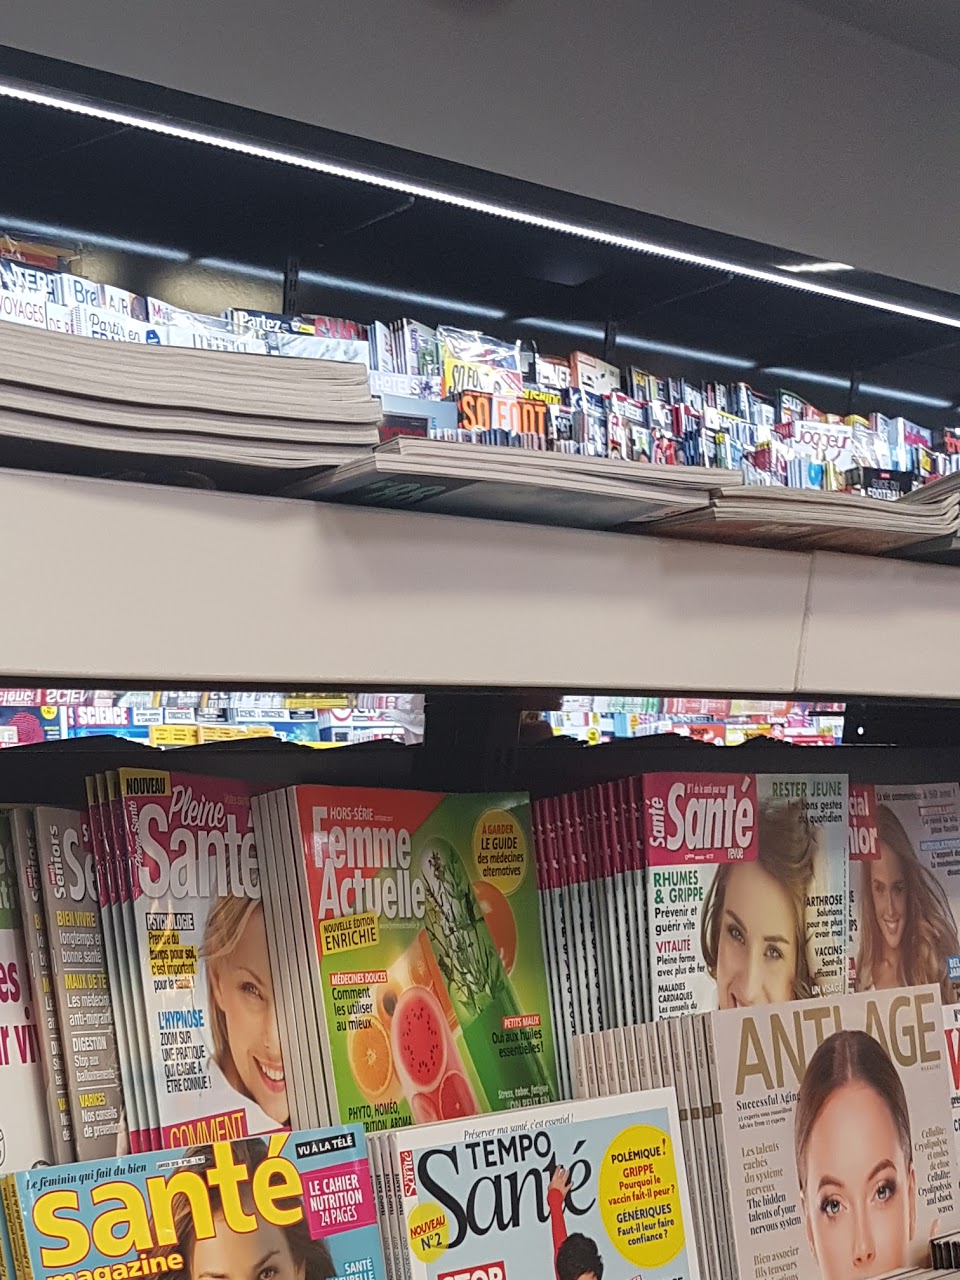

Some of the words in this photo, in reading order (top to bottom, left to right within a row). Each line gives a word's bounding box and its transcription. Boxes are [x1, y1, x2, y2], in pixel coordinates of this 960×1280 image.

[240, 311, 282, 332] Partez
[126, 778, 166, 795] NOUVEAU
[772, 781, 807, 798] RESTER
[811, 781, 842, 797] JEUNE
[169, 785, 226, 828] Pleine
[667, 775, 755, 852] Santé
[313, 806, 411, 868] Femme
[481, 838, 490, 849] LE
[492, 836, 517, 850] GUIDE
[318, 858, 426, 919] Actuelle
[653, 870, 699, 887] RHUMES
[655, 890, 664, 905] &
[669, 887, 703, 902] GRIPPE
[806, 894, 842, 907] ARTHROSE
[325, 928, 377, 951] ENRICHIE
[158, 1009, 205, 1030] L'HYPNOSE
[737, 1094, 780, 1111] Successful
[466, 1132, 552, 1169] TEMPO
[623, 1164, 654, 1178] GRIPPE
[308, 1180, 322, 1195] LE
[323, 1173, 359, 1193] CAHIER
[32, 1132, 303, 1268] santé
[310, 1189, 363, 1210] NUTRITION
[320, 1213, 330, 1226] 24
[330, 1207, 357, 1224] PAGES
[616, 1204, 672, 1224] GÉNÉRIQUES
[750, 1220, 778, 1236] nervous
[780, 1216, 802, 1230] system
